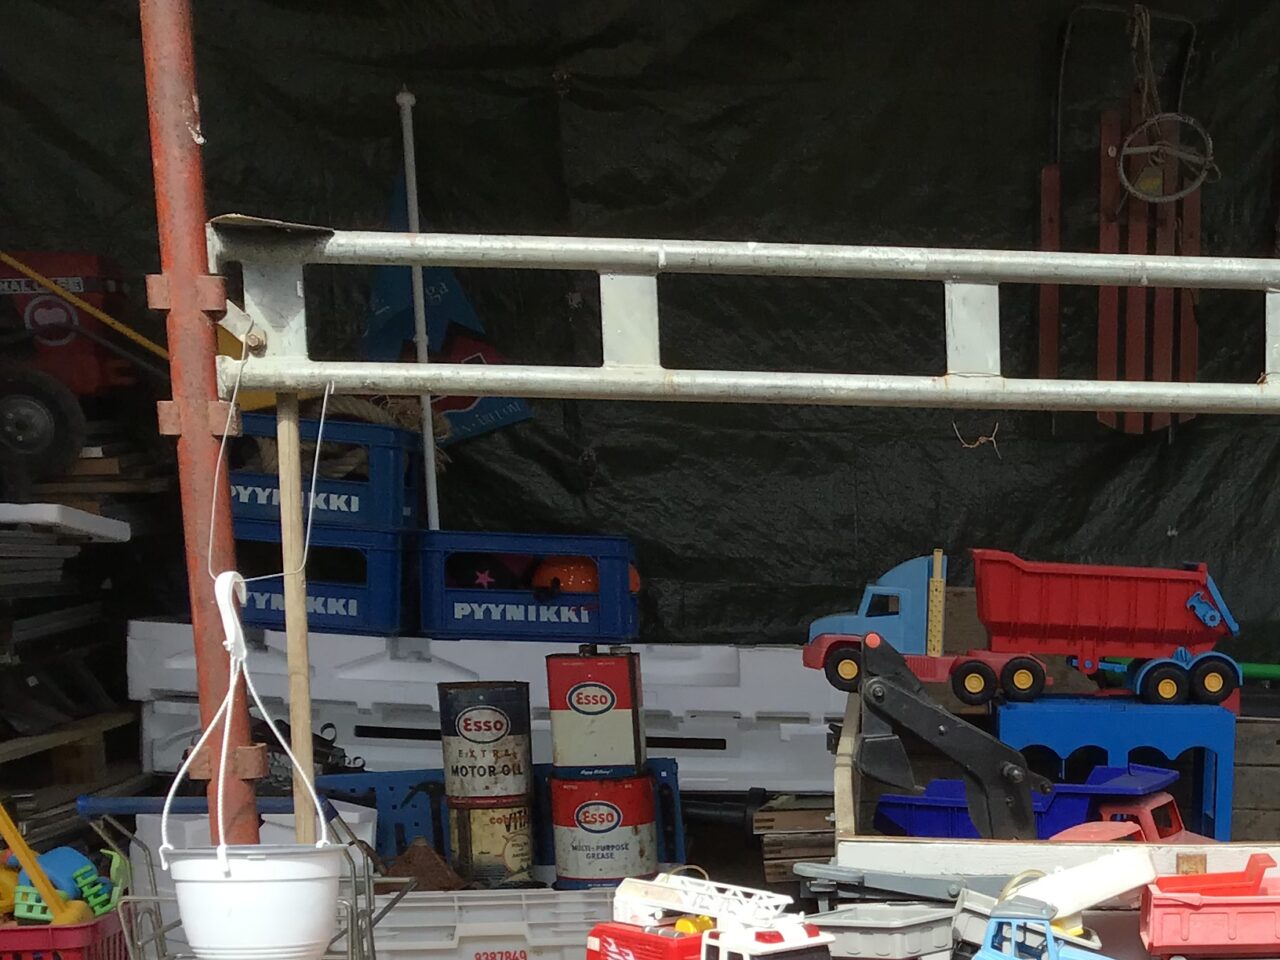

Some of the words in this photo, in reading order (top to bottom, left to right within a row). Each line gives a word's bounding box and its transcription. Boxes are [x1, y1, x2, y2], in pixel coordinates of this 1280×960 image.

[453, 602, 589, 623] PYYNIKKI
[451, 764, 497, 777] MOTOR
[502, 762, 524, 777] OIL
[585, 852, 615, 860] GREASE
